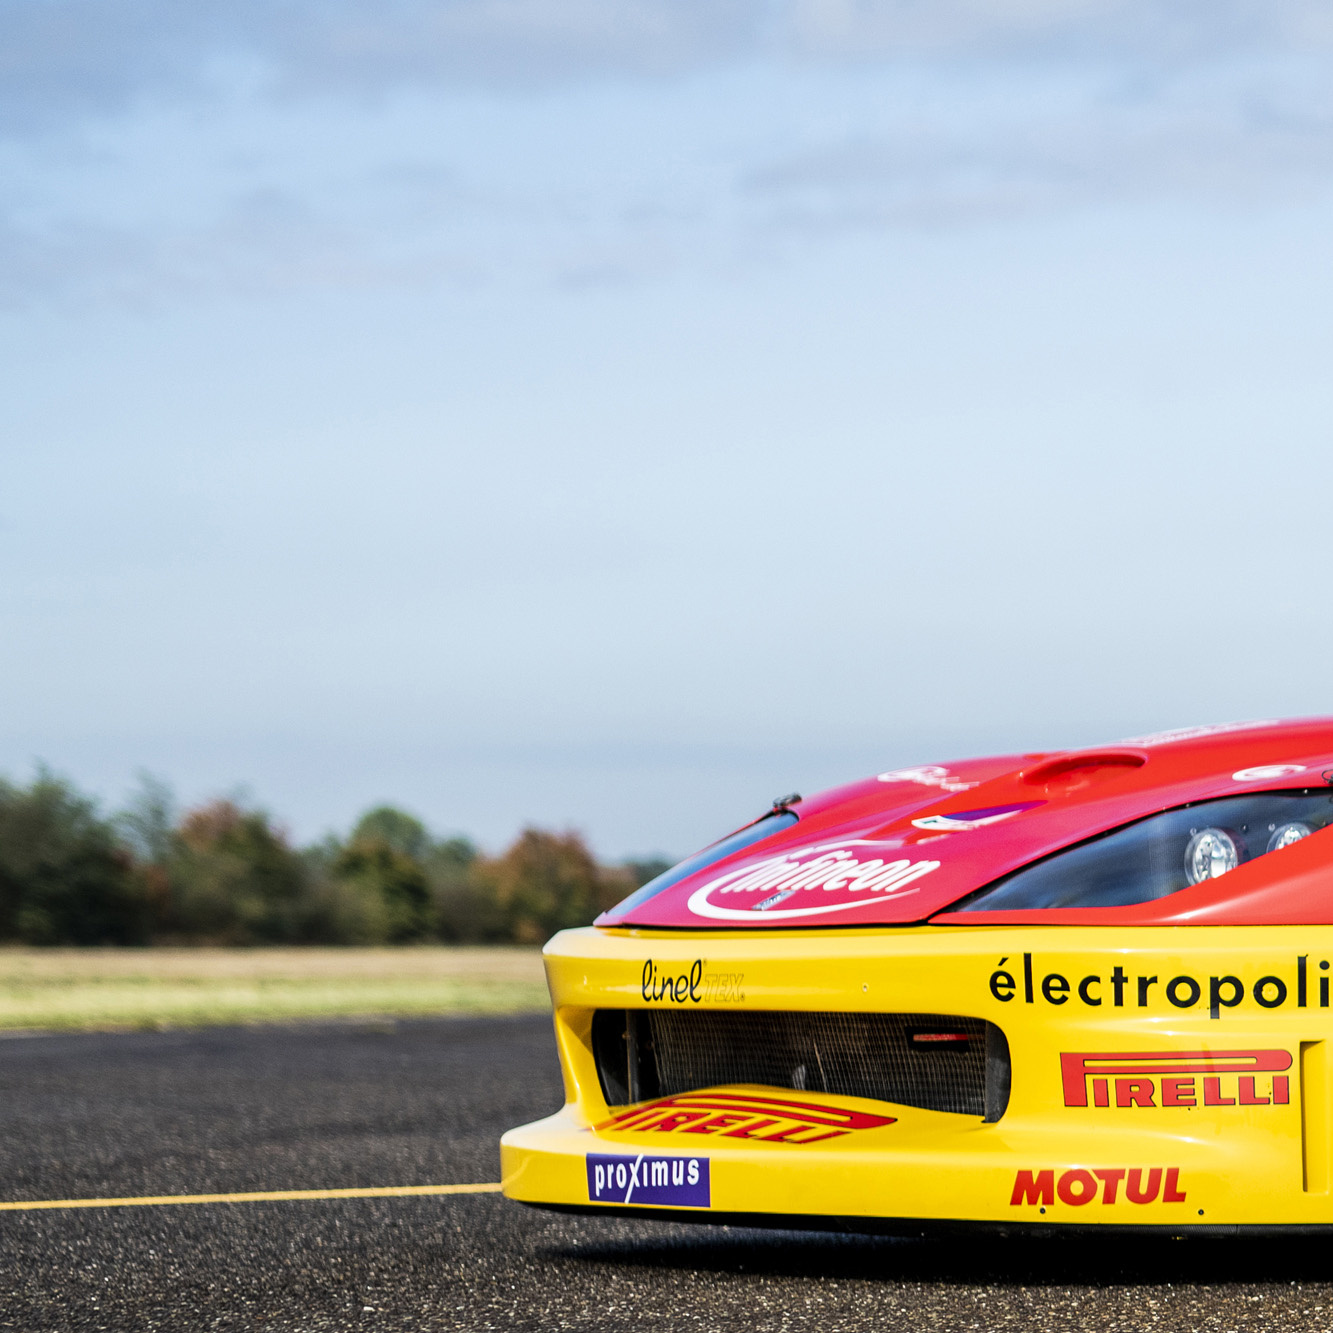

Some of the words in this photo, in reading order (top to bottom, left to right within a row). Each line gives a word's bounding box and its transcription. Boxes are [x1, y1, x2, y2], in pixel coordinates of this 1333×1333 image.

[642, 958, 702, 1003] linel
[989, 952, 1331, 1019] électropoli
[1060, 1049, 1293, 1107] PIRELLI
[581, 1093, 898, 1145] PIRELLI
[595, 1153, 700, 1205] proximus
[1009, 1167, 1187, 1206] MOTUL
